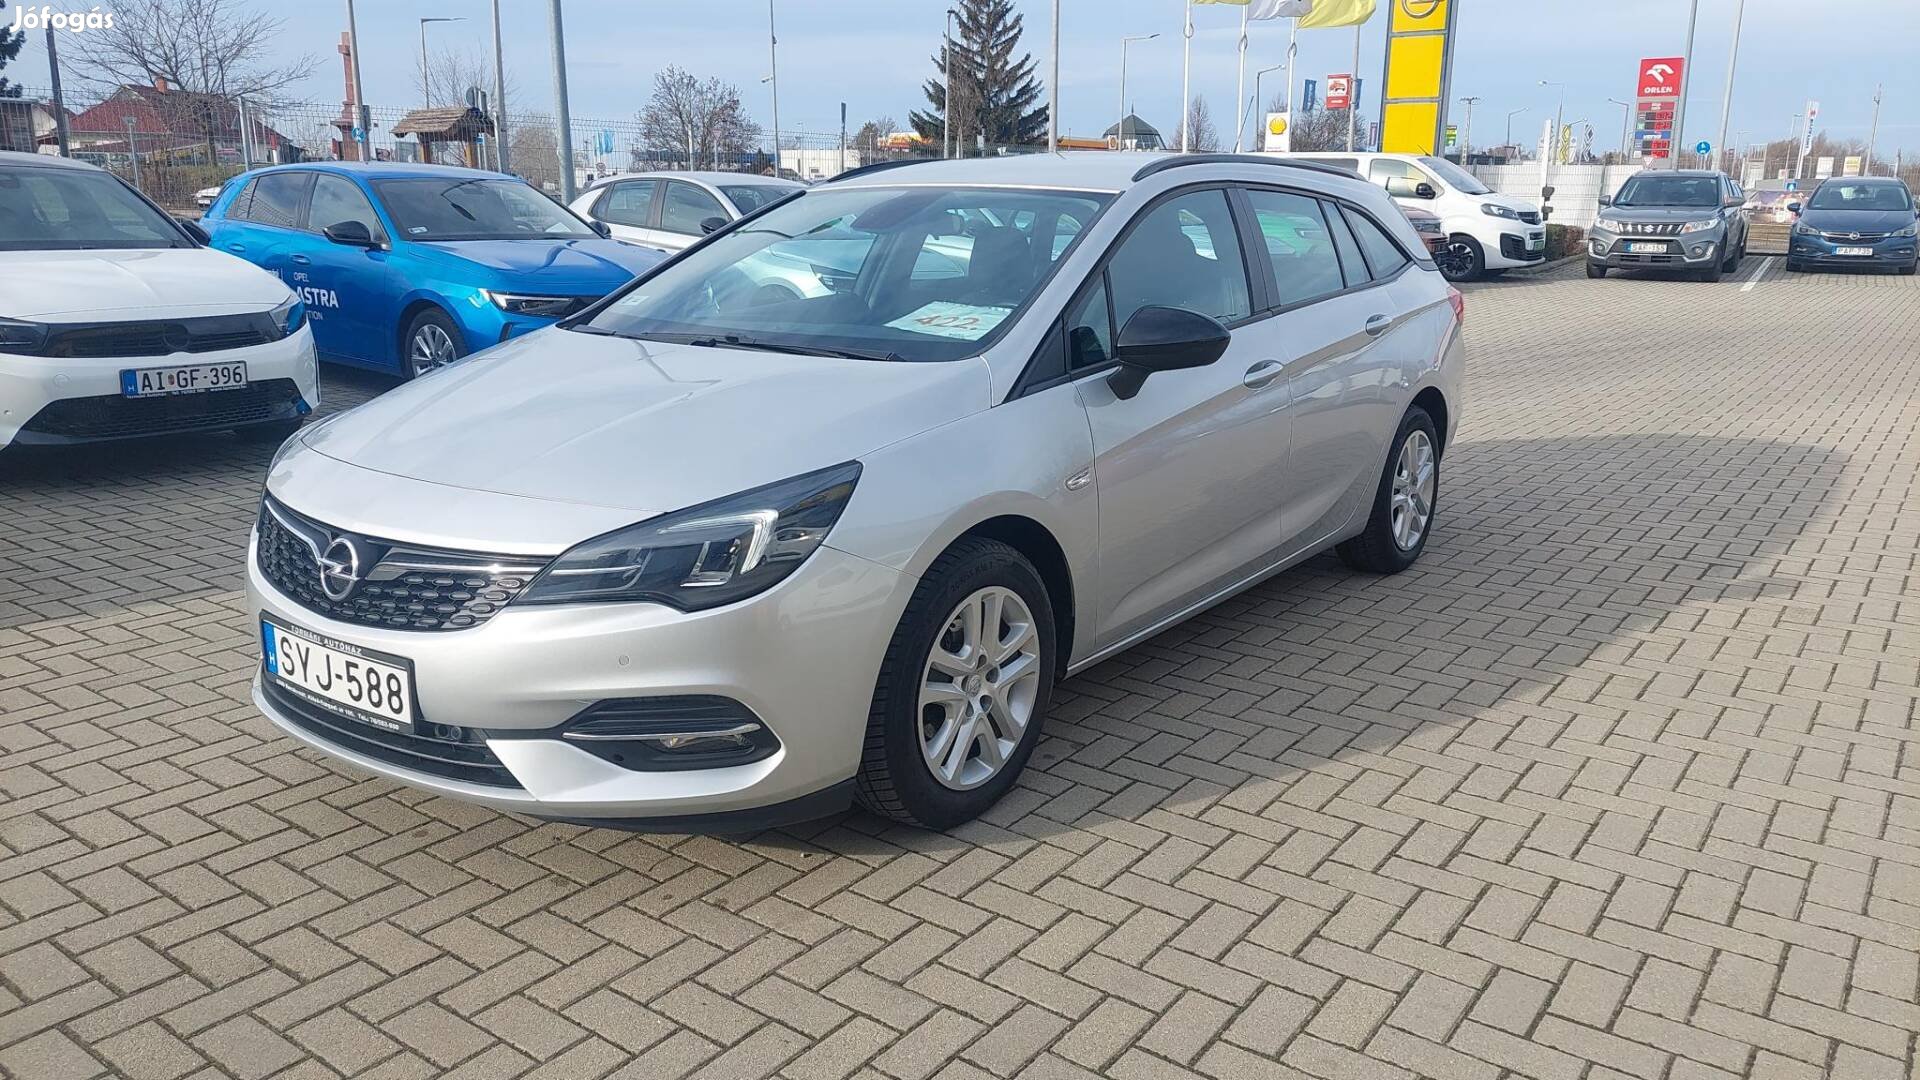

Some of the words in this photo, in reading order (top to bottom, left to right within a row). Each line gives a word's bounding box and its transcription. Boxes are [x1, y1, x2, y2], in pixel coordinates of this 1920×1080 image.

[1644, 86, 1673, 94] ORLEN
[294, 271, 310, 282] OPEL
[296, 286, 339, 308] ASTRA
[306, 311, 323, 320] TION
[280, 636, 404, 714] SYJ-588
